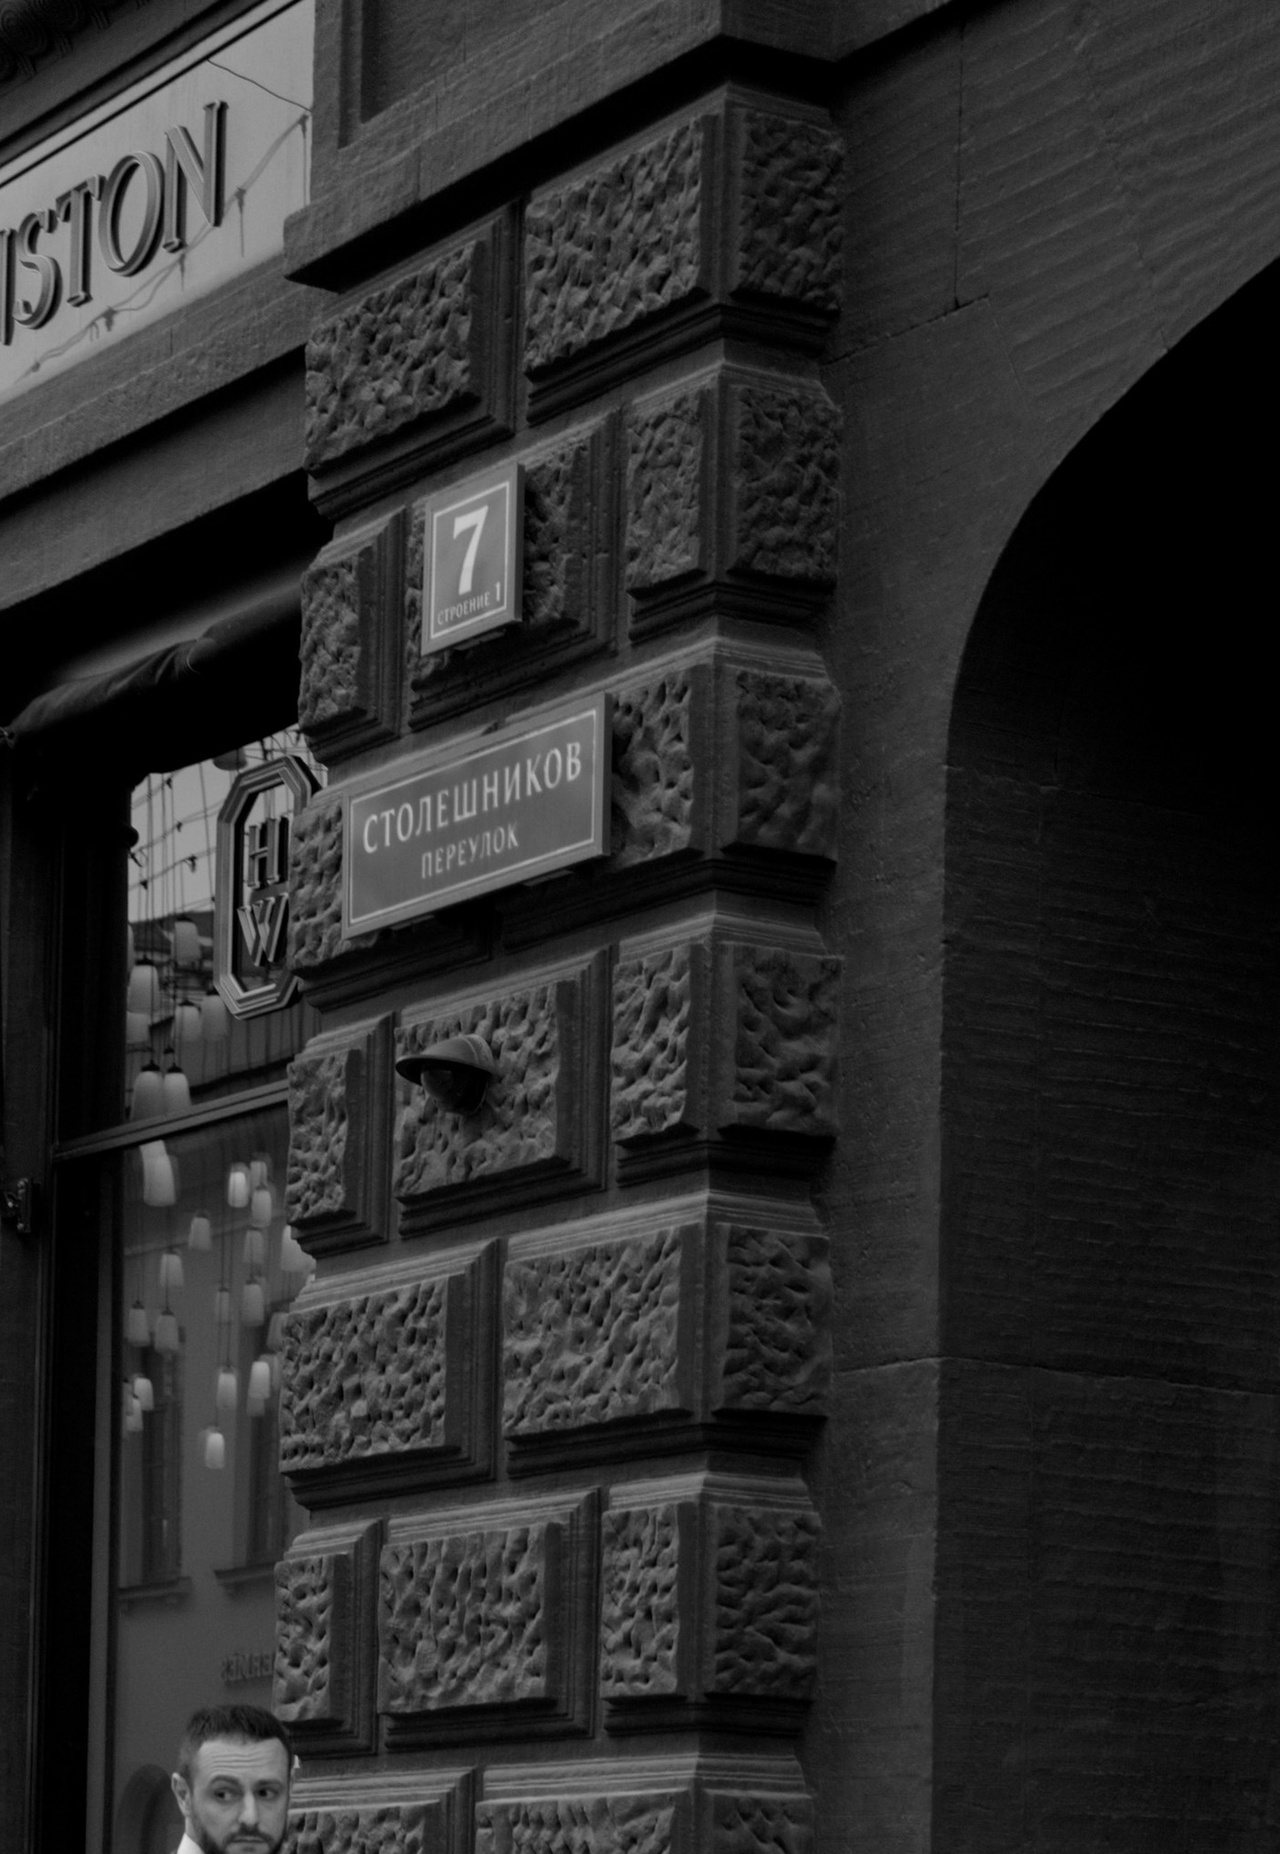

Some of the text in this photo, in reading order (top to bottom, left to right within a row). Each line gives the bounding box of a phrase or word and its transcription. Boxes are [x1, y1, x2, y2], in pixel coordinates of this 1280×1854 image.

[453, 504, 489, 596] 7
[437, 580, 502, 625] СТРОЕНИЕ 1
[363, 741, 582, 854] СТОЛЕШНИКОВ
[421, 822, 519, 879] ПЕРЕУЛОК
